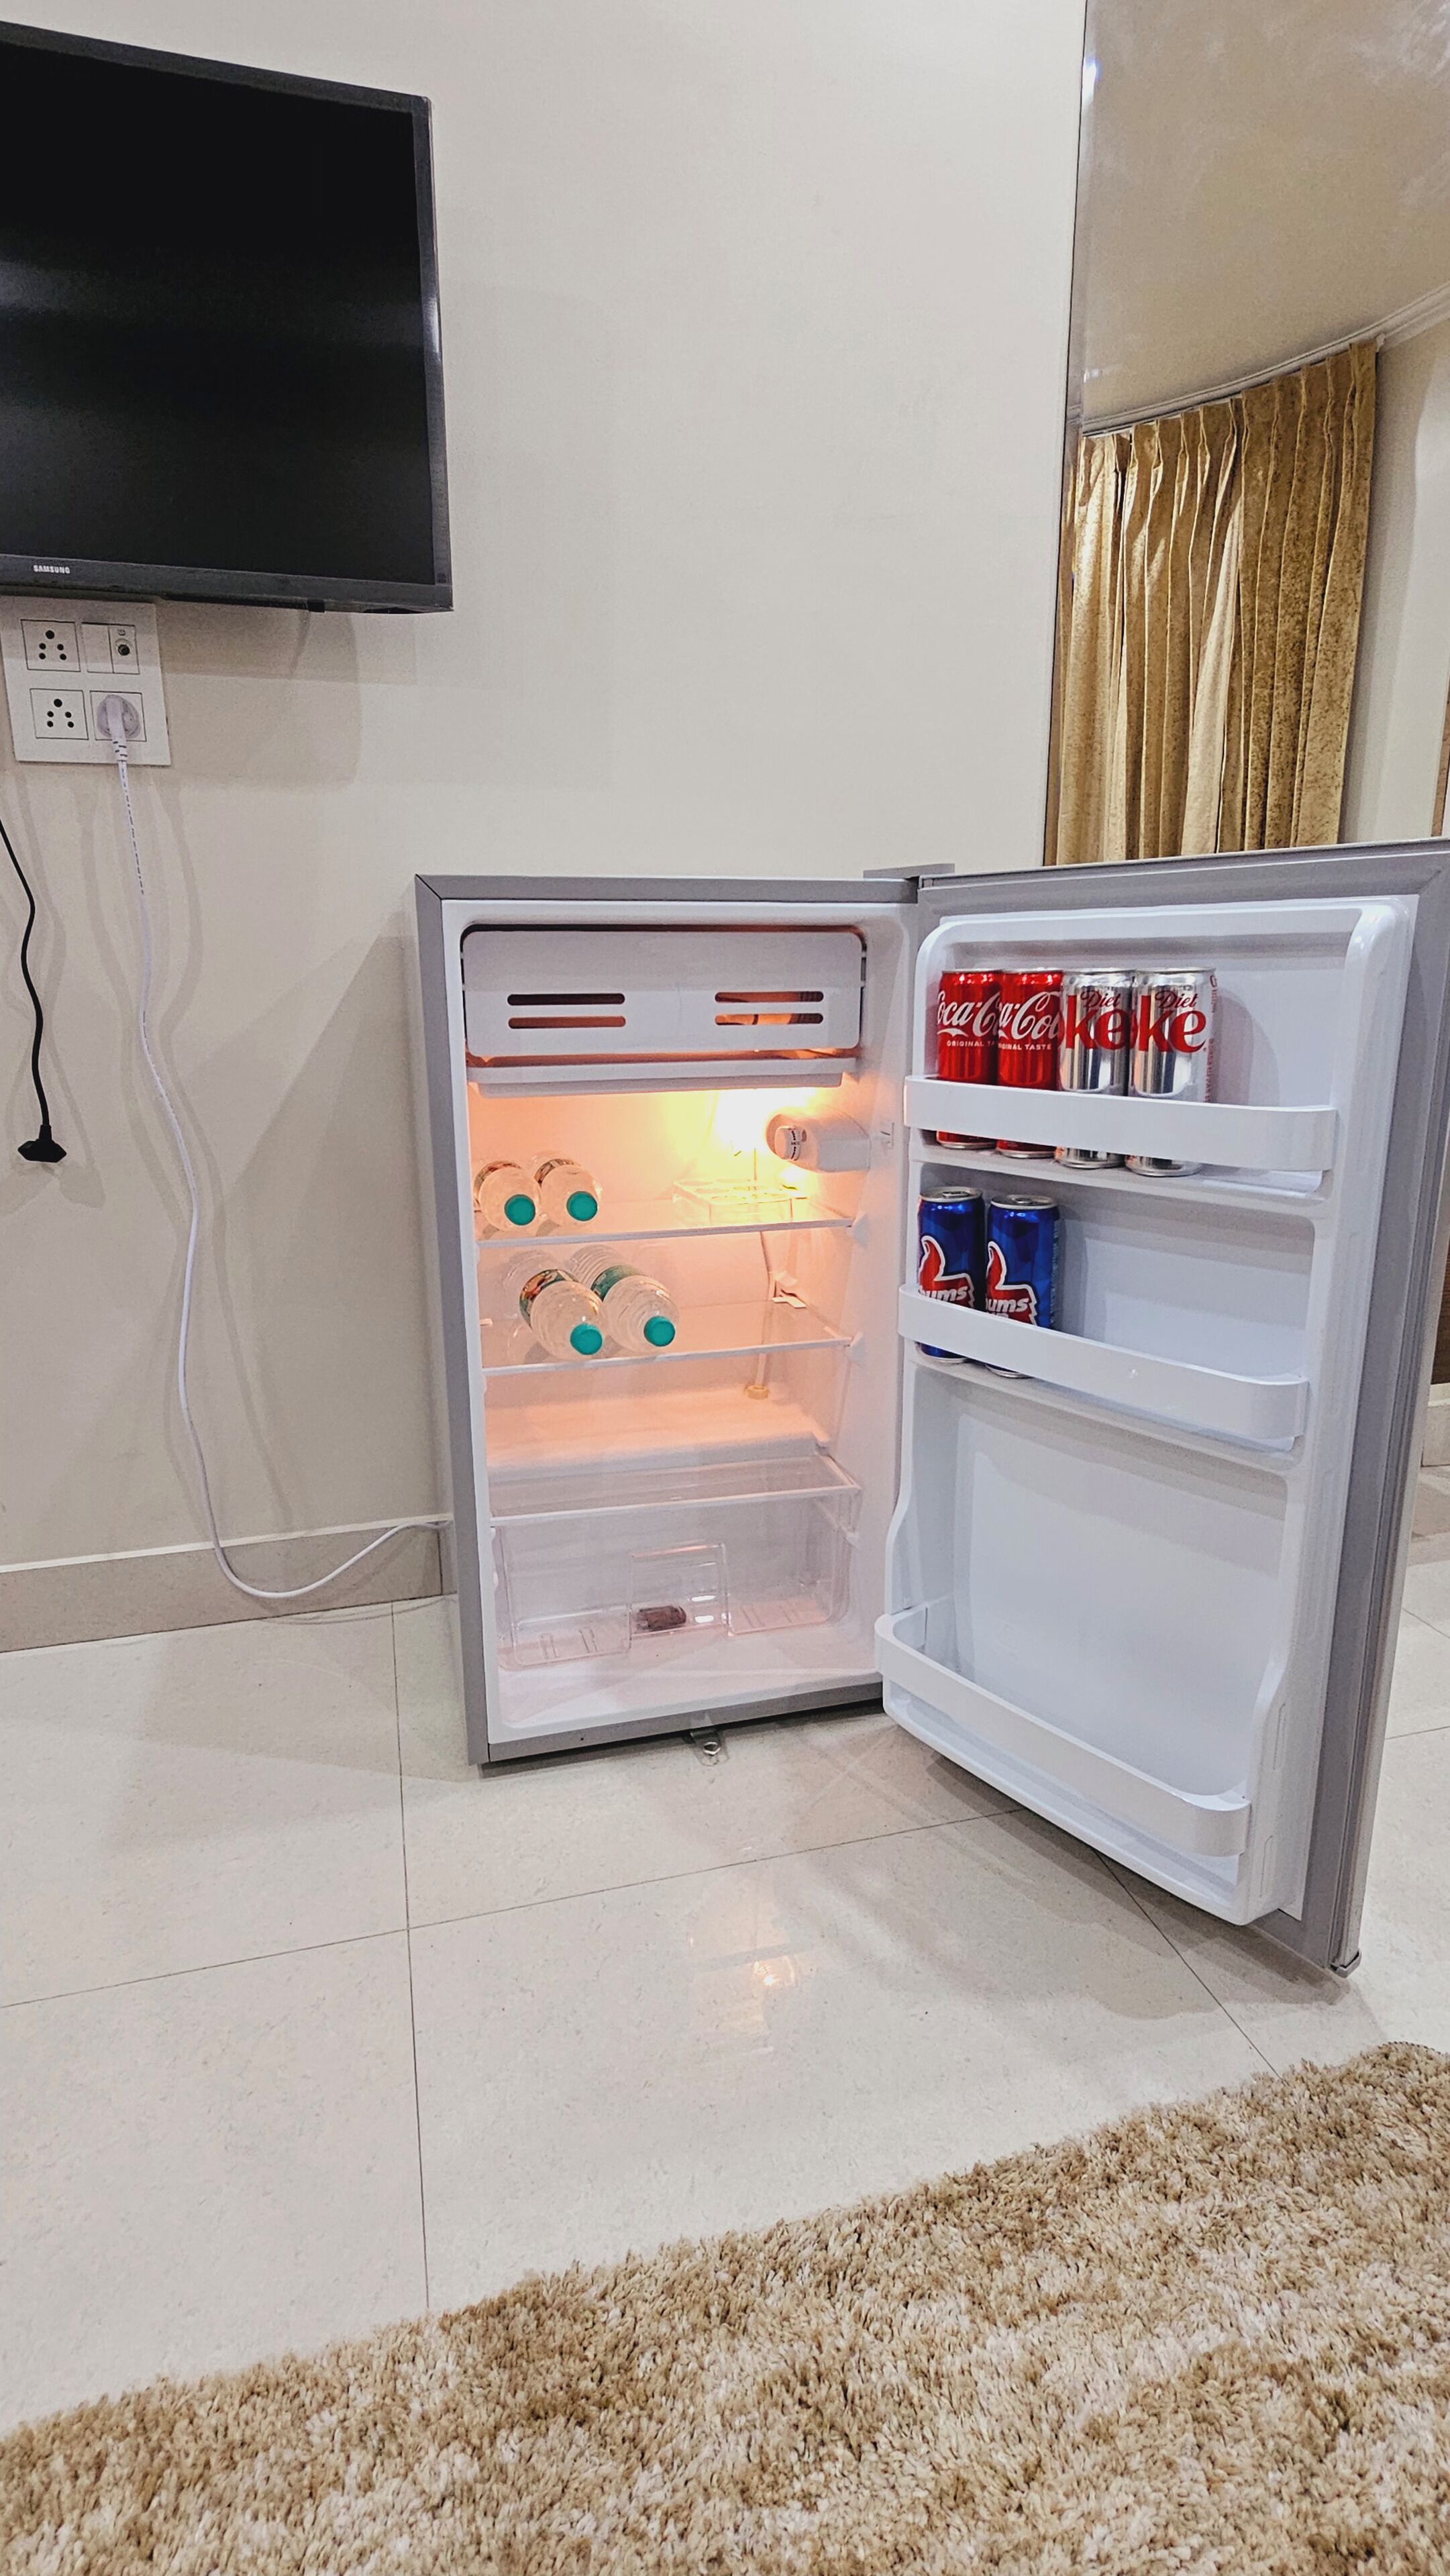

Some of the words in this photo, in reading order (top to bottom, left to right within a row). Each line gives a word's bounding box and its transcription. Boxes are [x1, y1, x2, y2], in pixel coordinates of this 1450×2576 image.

[33, 564, 70, 574] SAMSUNG
[1080, 989, 1122, 1008] Diet
[1155, 989, 1198, 1009] Diet
[1058, 995, 1130, 1051] ke
[1131, 995, 1207, 1053] ke
[985, 1297, 1030, 1313] ums
